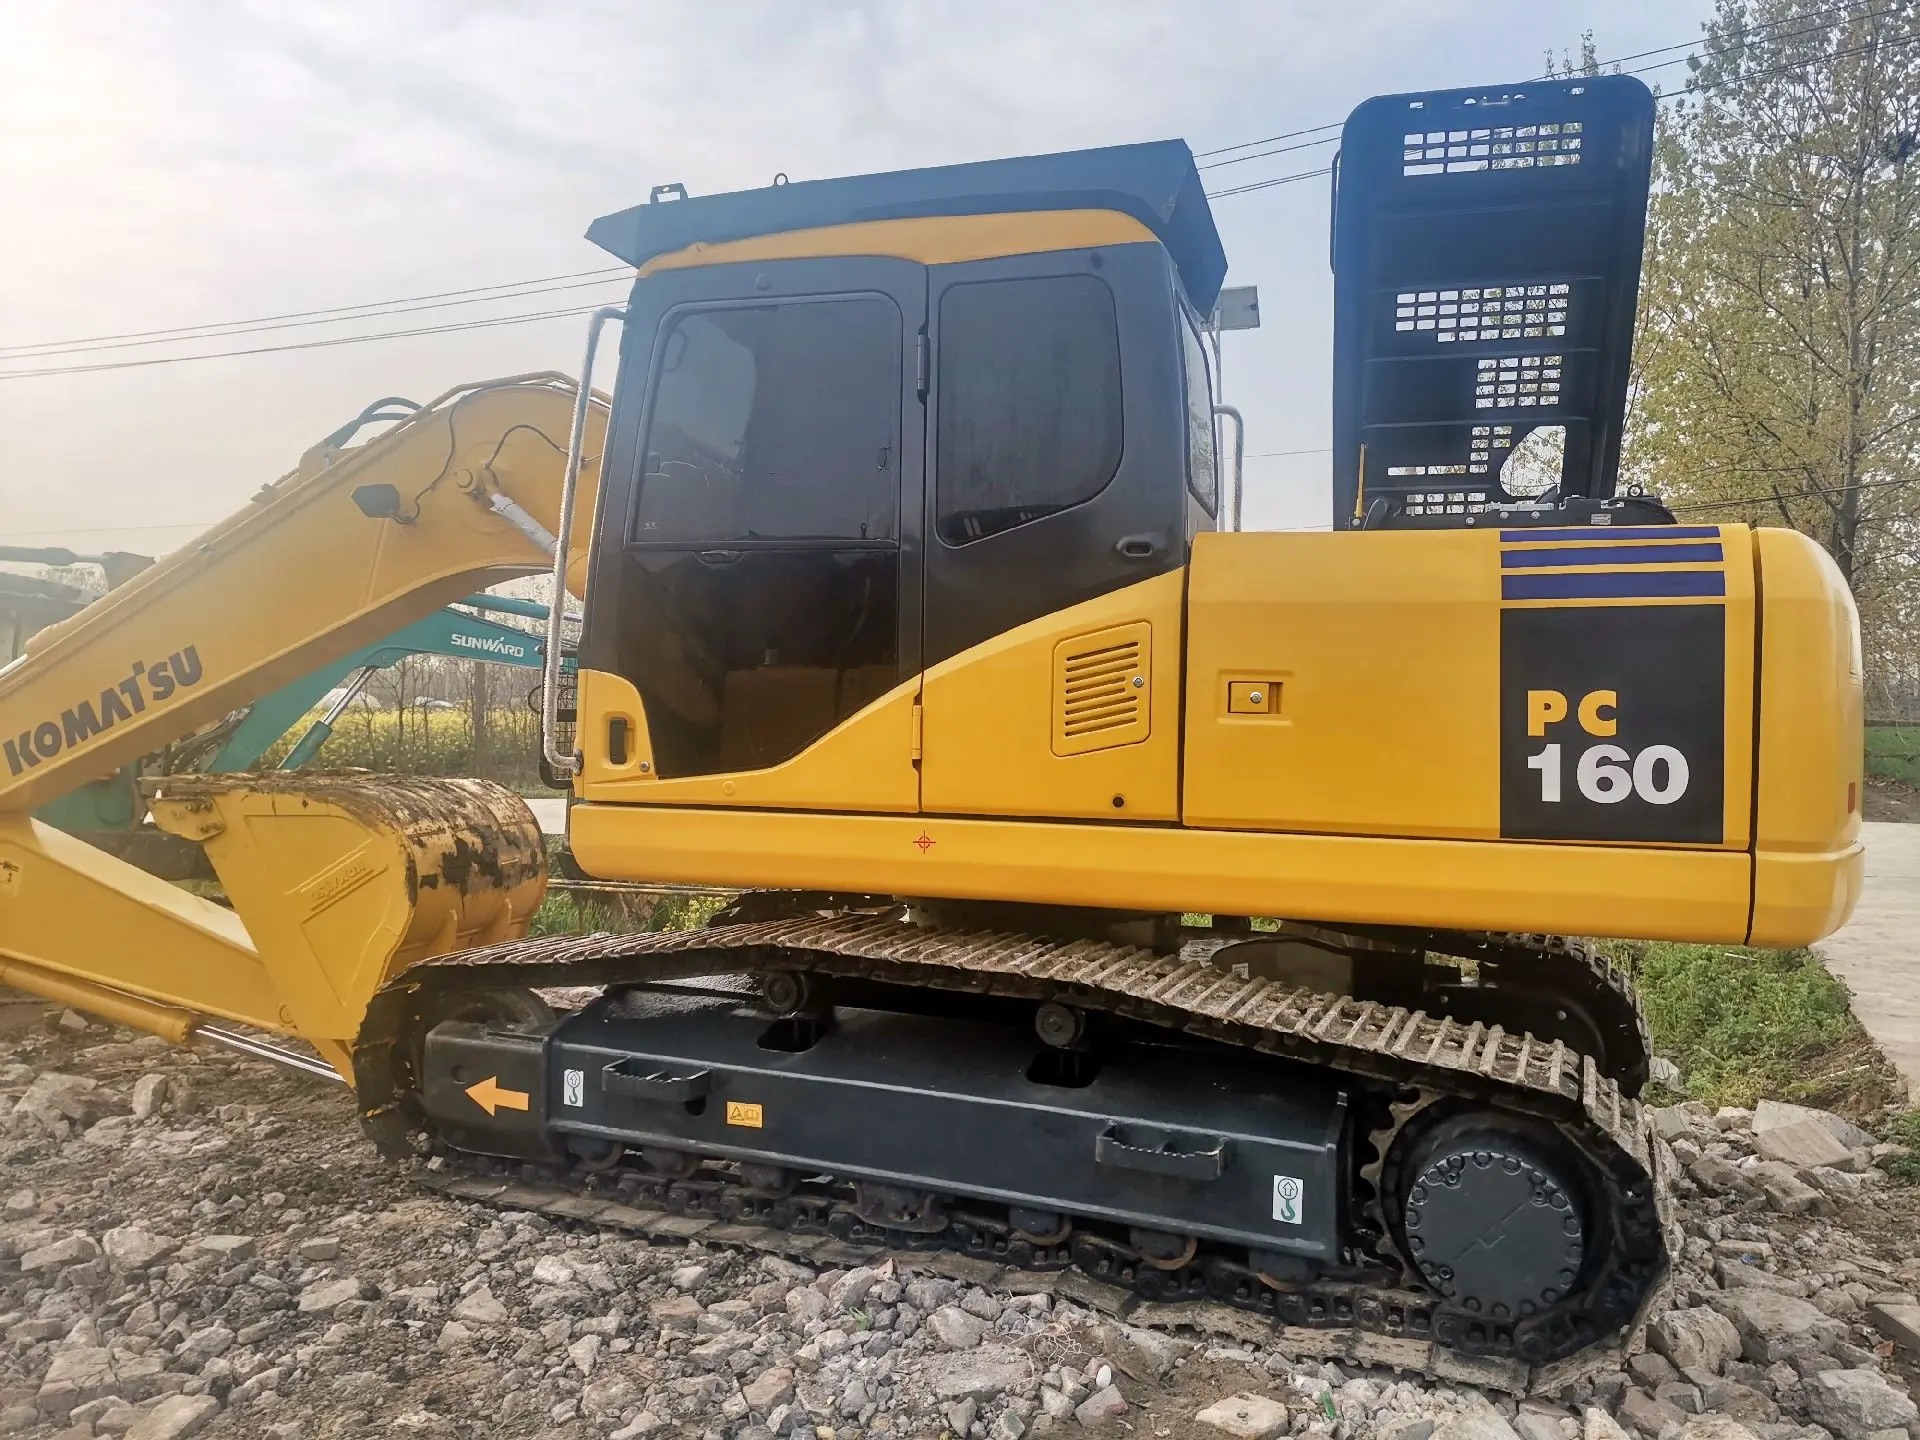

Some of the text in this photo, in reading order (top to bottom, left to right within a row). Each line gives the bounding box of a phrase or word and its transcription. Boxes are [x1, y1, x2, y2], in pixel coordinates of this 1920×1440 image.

[451, 634, 524, 657] SUNWARD
[3, 644, 202, 776] KOMATSU
[1528, 690, 1617, 737] PC
[1528, 744, 1690, 805] 160
